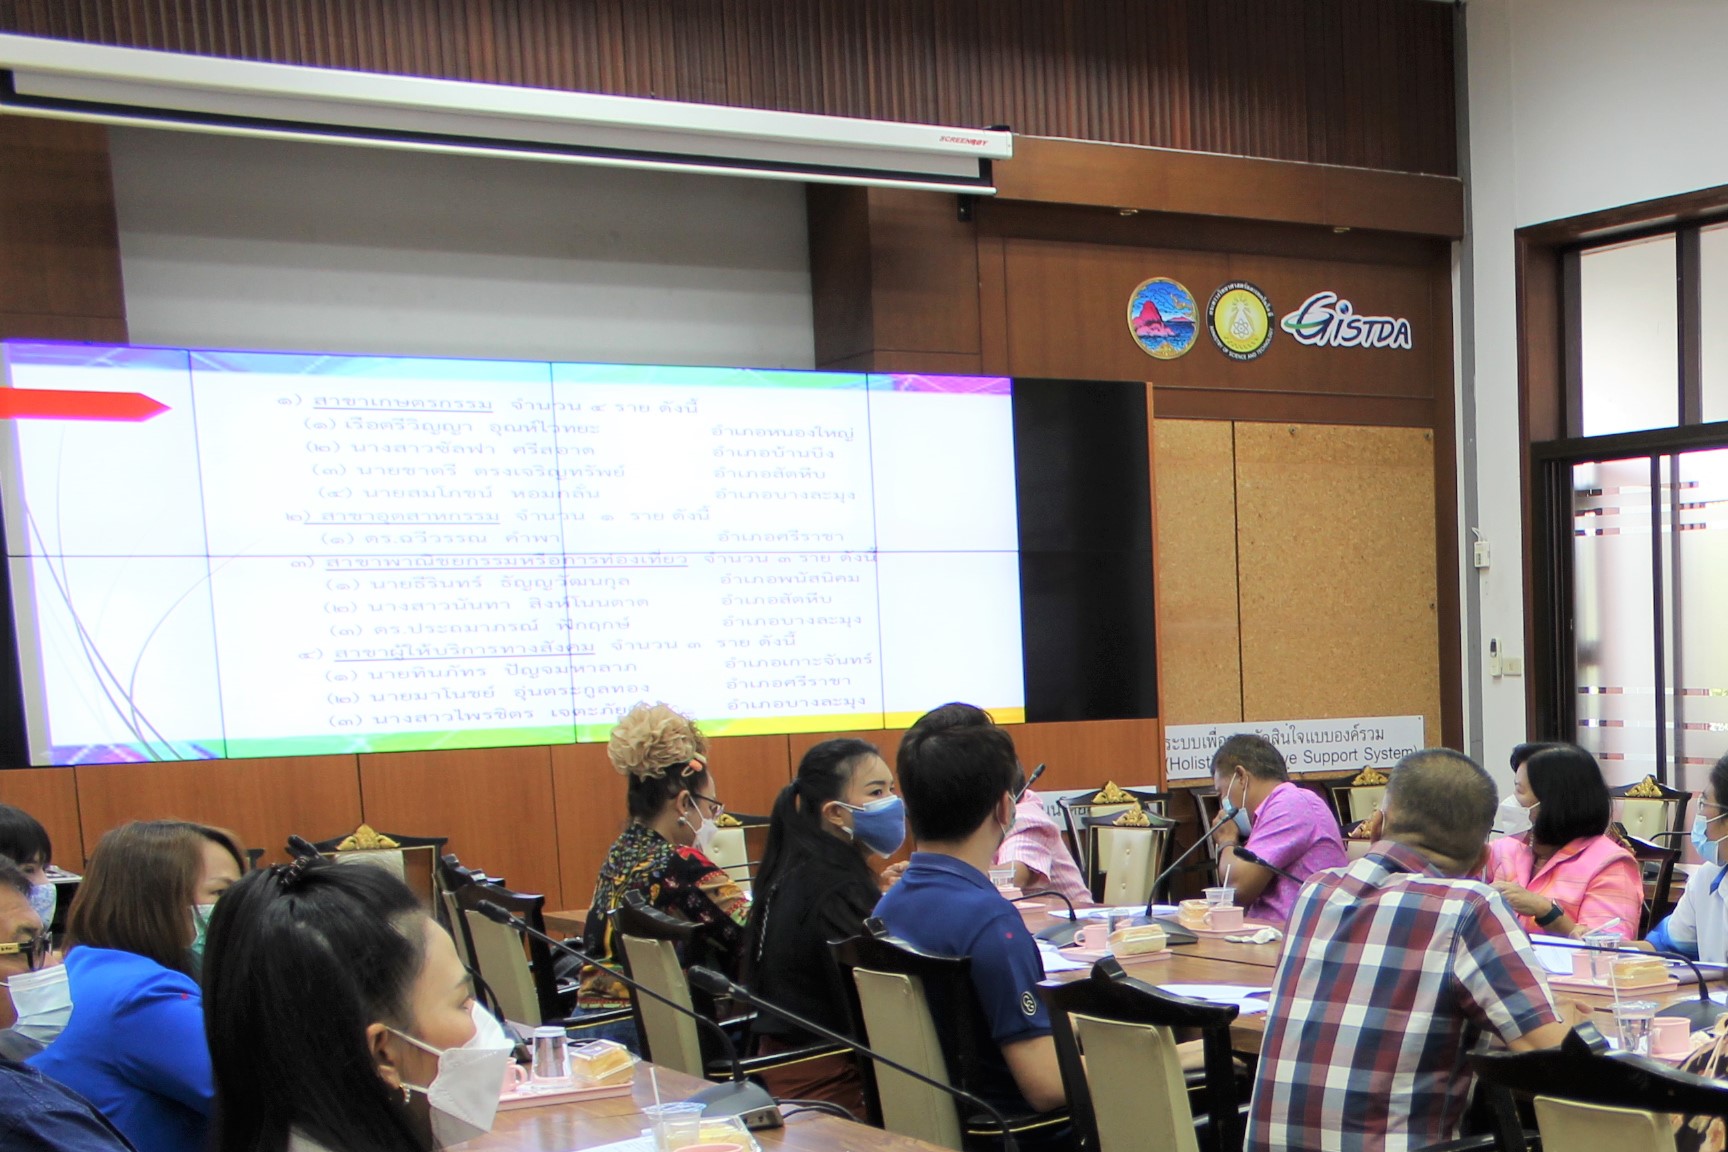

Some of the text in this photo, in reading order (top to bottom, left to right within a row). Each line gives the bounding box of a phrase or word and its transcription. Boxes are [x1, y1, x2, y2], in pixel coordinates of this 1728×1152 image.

[313, 396, 493, 409] สาขาเกษตรกรรม
[615, 402, 650, 413] ราย
[1303, 748, 1358, 767] Support
